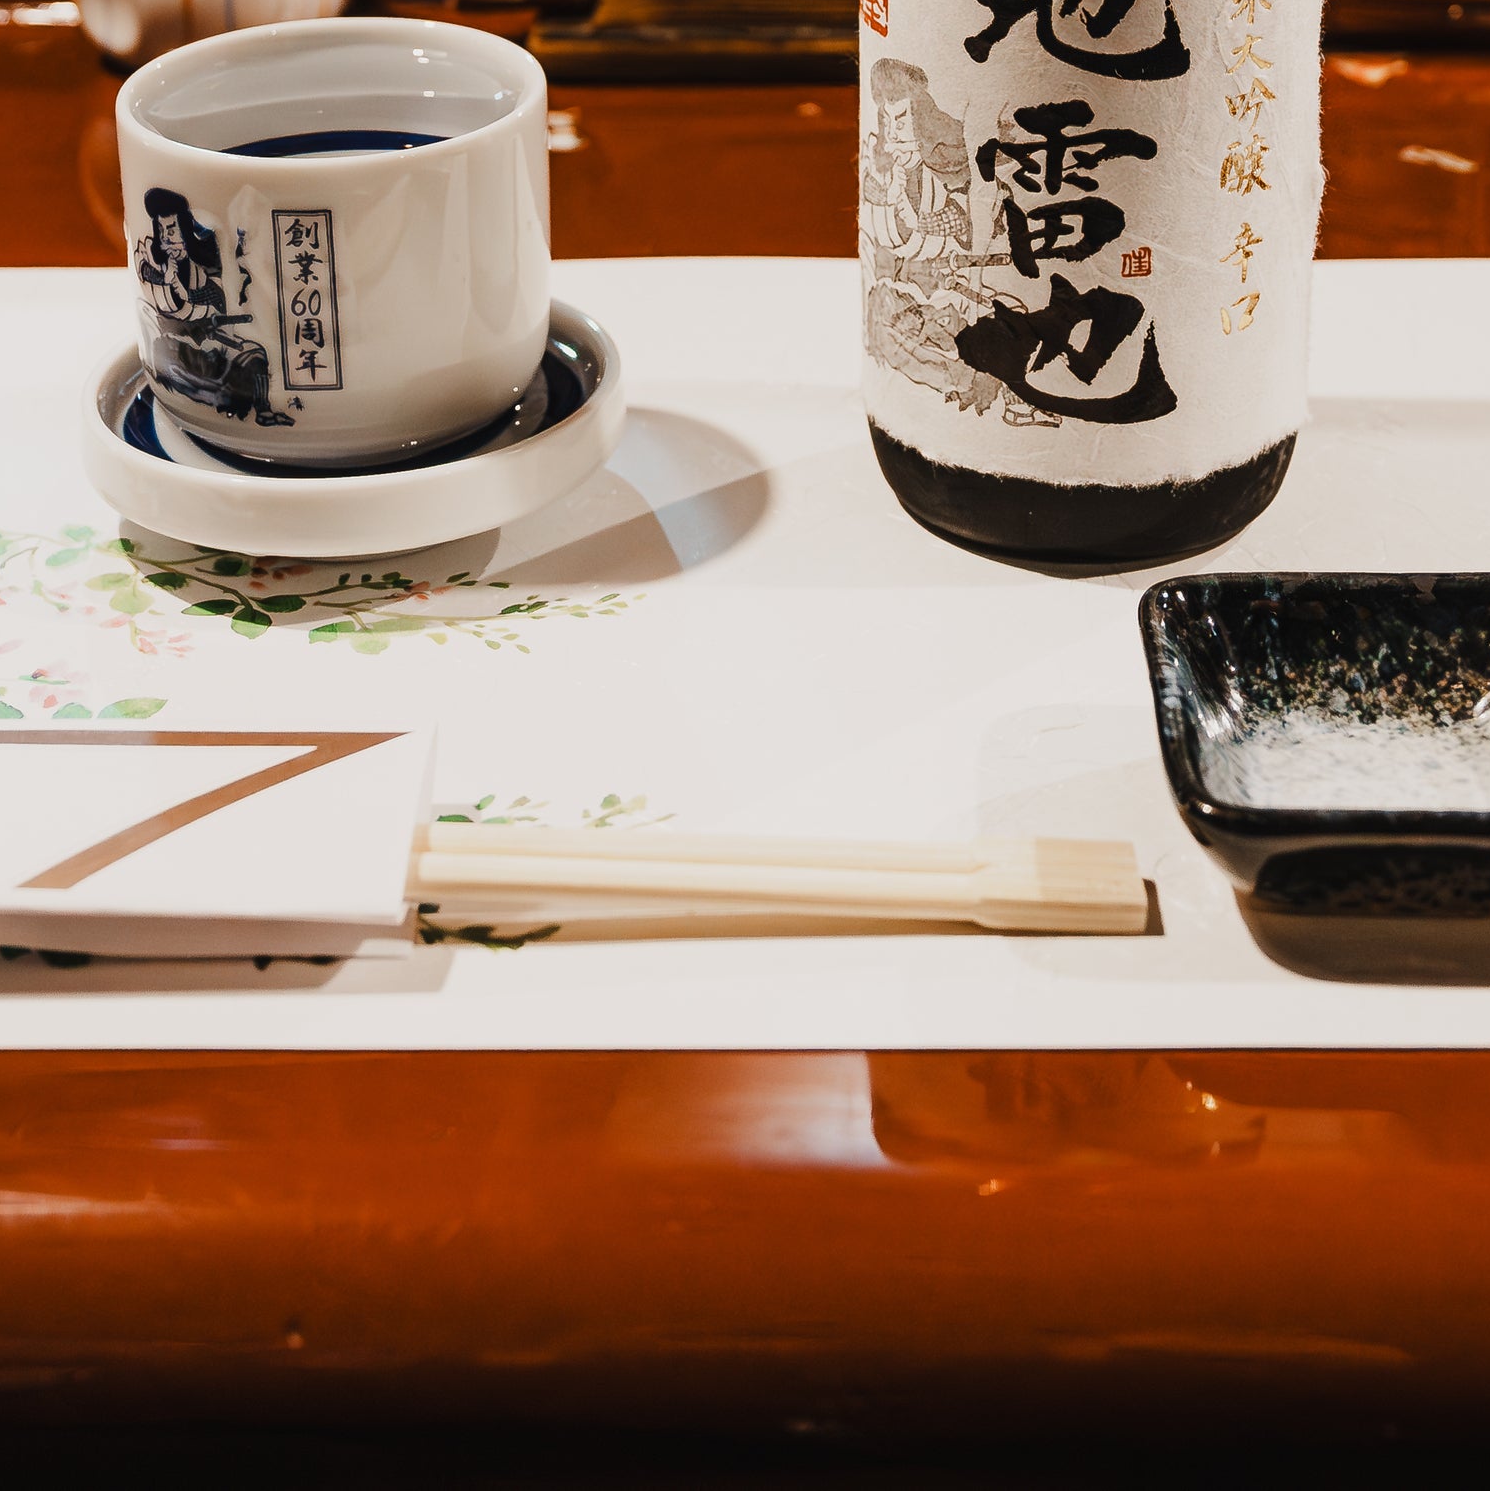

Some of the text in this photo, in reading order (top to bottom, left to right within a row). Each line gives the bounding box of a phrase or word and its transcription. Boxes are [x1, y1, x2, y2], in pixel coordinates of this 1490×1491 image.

[284, 218, 327, 382] 創業60周年
[1219, 222, 1264, 338] 辛口
